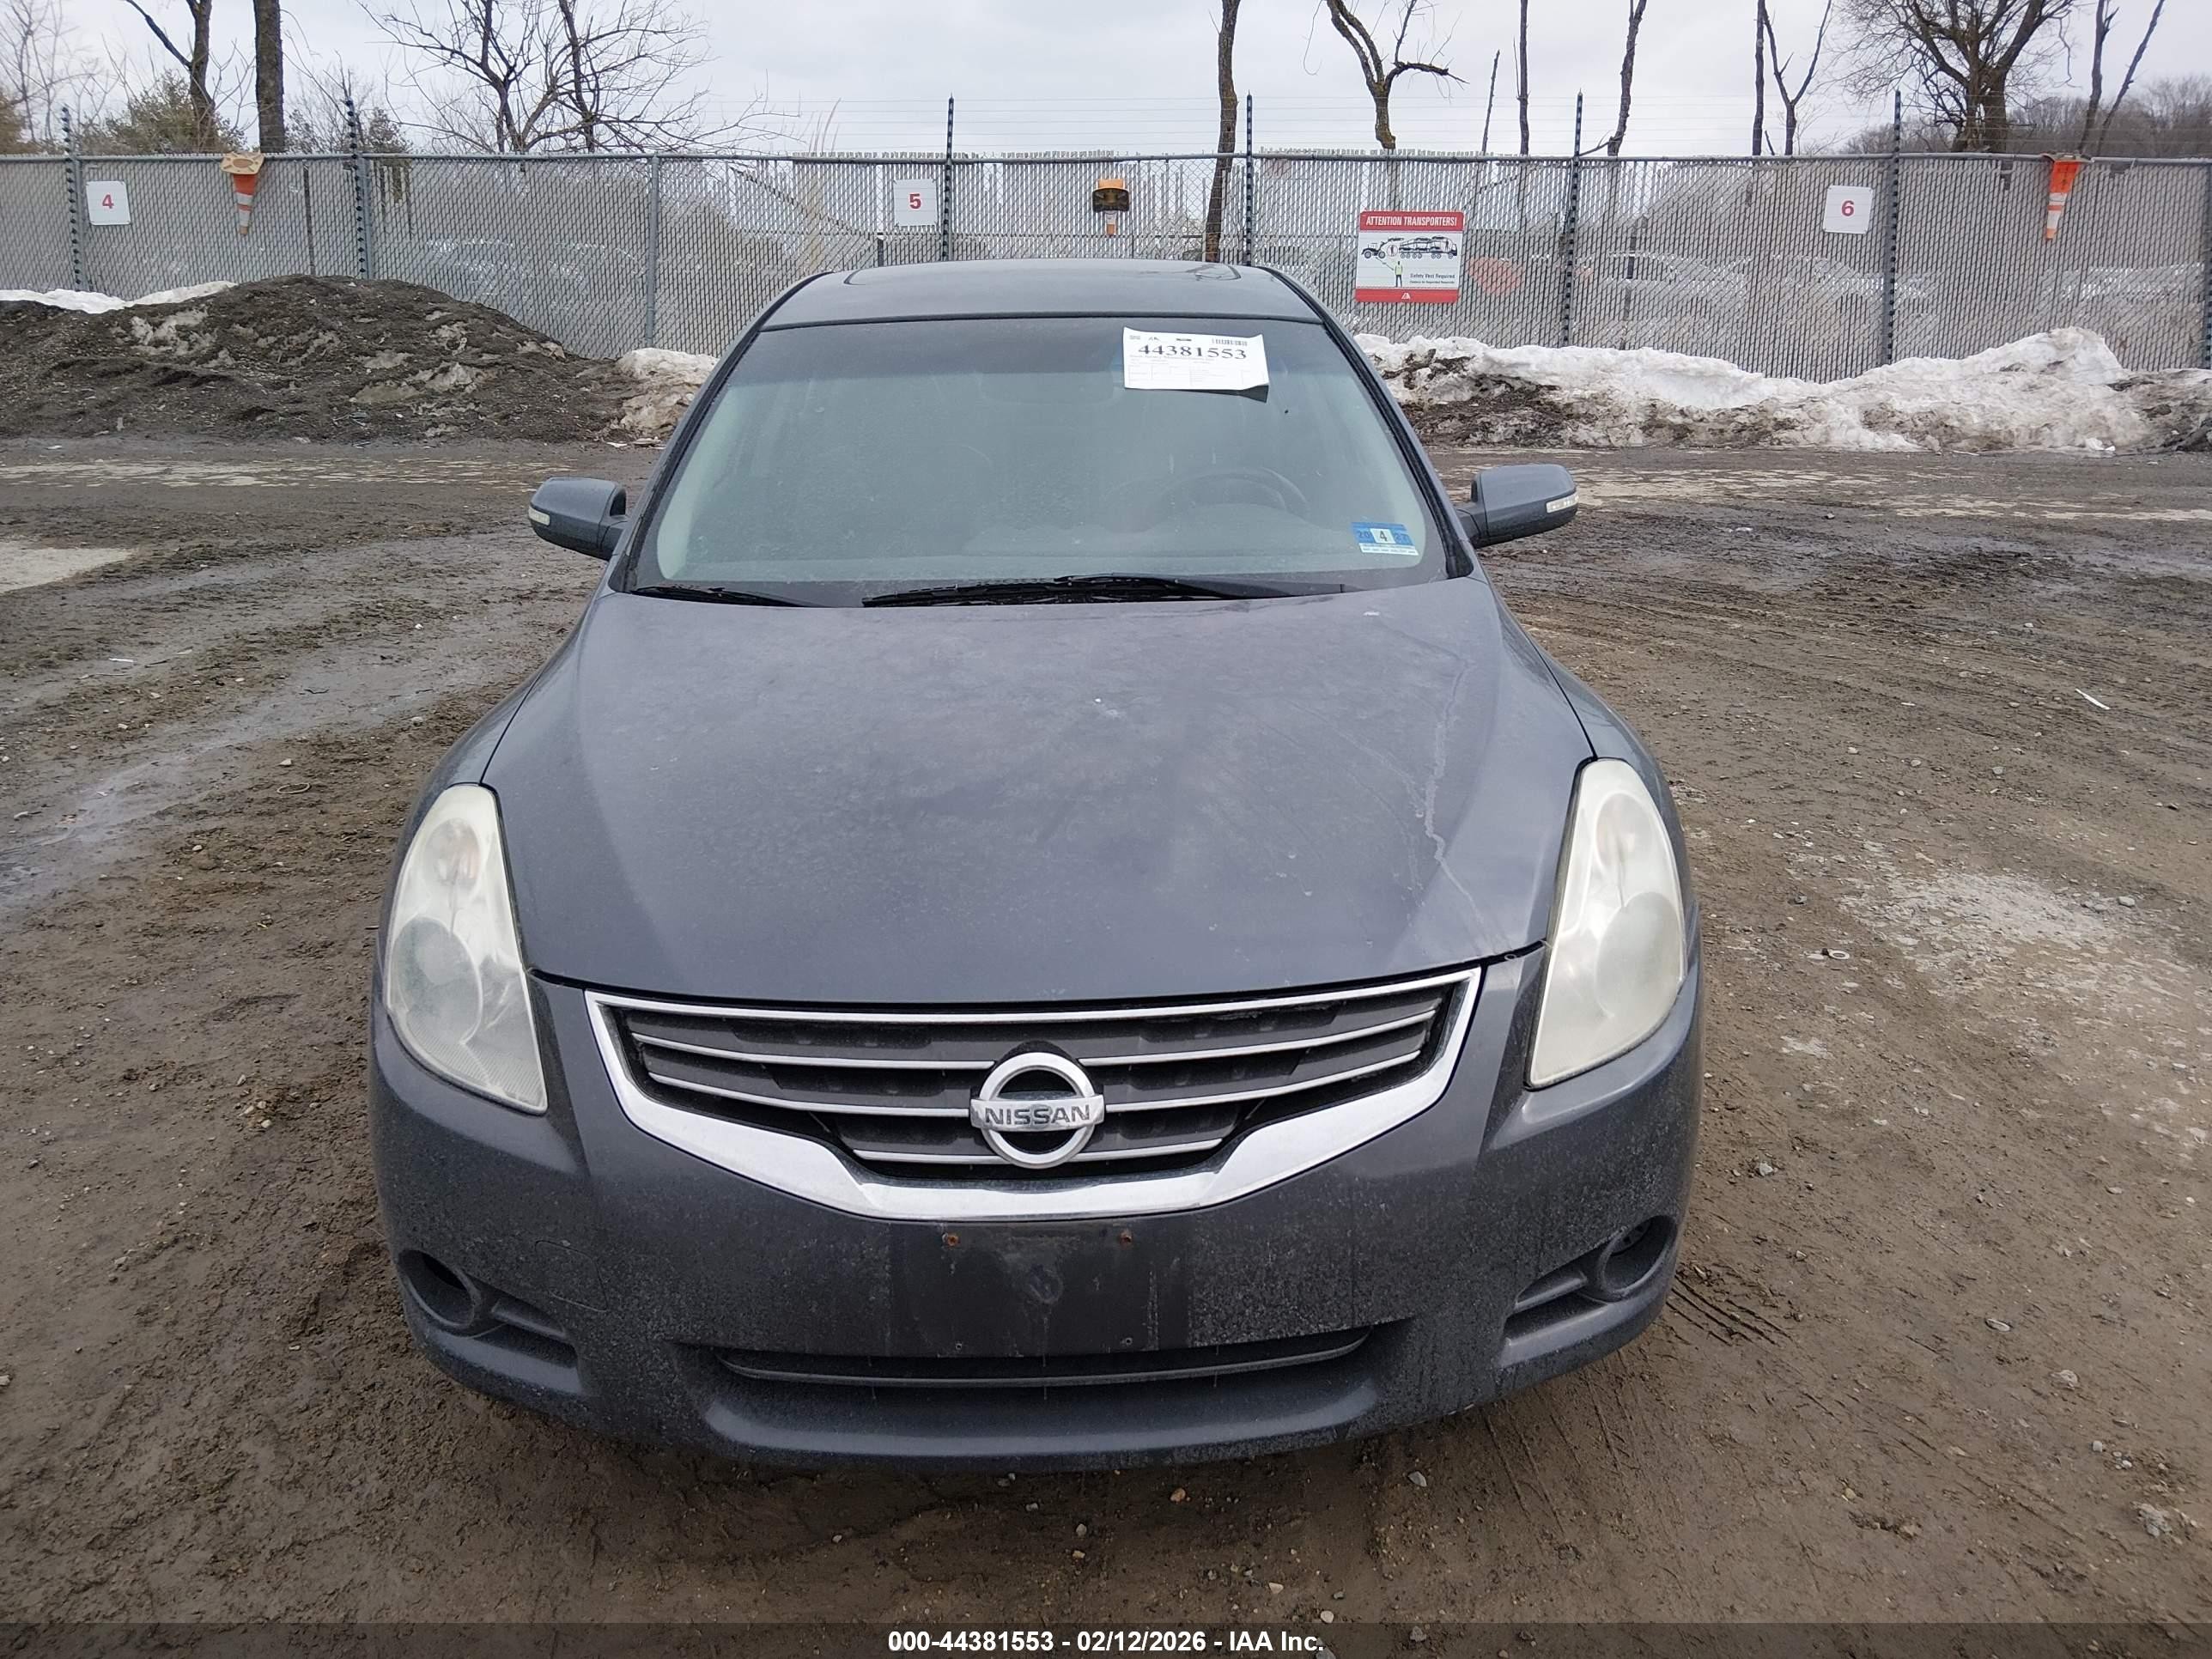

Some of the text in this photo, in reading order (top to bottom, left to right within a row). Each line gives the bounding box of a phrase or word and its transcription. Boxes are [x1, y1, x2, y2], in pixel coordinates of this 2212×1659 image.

[101, 194, 114, 210] 4
[908, 193, 922, 210] 5
[1841, 200, 1855, 216] 6
[1365, 216, 1457, 226] ATTENTION TRANSPORTERS!
[1138, 344, 1247, 360] 44381553
[1379, 530, 1388, 542] 4
[985, 1104, 1091, 1126] NISSAN
